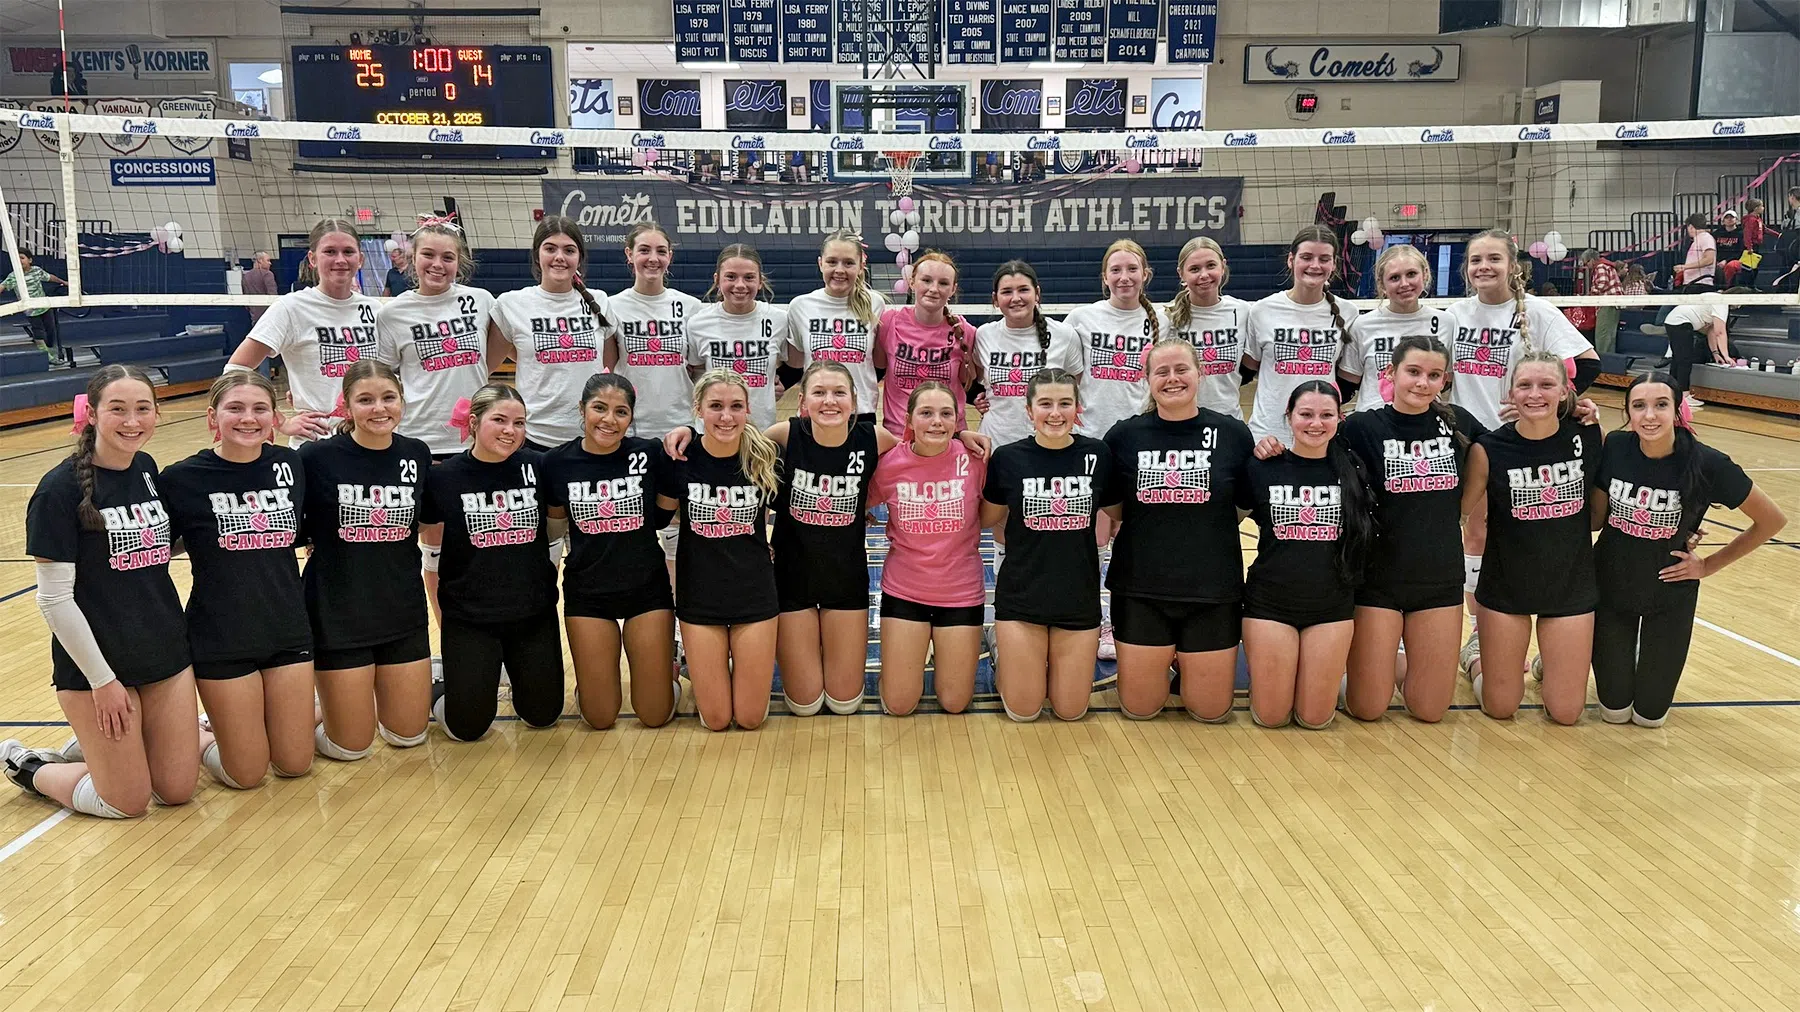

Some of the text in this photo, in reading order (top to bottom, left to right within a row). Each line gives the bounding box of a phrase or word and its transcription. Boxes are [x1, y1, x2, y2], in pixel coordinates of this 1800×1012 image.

[676, 4, 720, 14] LISA FERRY
[730, 0, 774, 8] LISA FERRY
[784, 5, 828, 14] LISA FERRY
[966, 2, 990, 10] DIVING
[1004, 4, 1049, 14] LANCE WARD
[1169, 5, 1216, 16] CHEERLEADING
[690, 19, 708, 28] 1978
[742, 12, 762, 20] 1979
[798, 19, 816, 28] 1980
[949, 14, 995, 24] TED HARRIS
[1016, 19, 1036, 28] 2007
[1070, 12, 1092, 20] 2009
[734, 24, 772, 33] STATE CHAMPION
[962, 28, 982, 36] 2005
[1062, 24, 1100, 33] STATE CHAMPION
[685, 34, 724, 42] STATE CHAMPION
[734, 36, 772, 46] SHOT PUT
[788, 34, 826, 42] STATE CHAMPION
[1006, 33, 1046, 42] STATE CHAMPION
[1069, 36, 1088, 46] METER
[1183, 34, 1203, 44] STATE
[350, 50, 372, 60] HOME
[458, 50, 482, 60] GUEST
[682, 48, 719, 56] SHOT PUT
[740, 48, 767, 58] DISCUS
[788, 48, 826, 56] SHOT PUT
[1070, 49, 1088, 58] METER
[1118, 45, 1146, 56] 2014
[1175, 48, 1210, 59] CHAMPIONS
[71, 51, 124, 71] KENT'S
[144, 51, 210, 71] KORNER
[413, 48, 452, 72] 1:00
[1310, 48, 1396, 77] Comets
[356, 63, 384, 86] 25
[473, 65, 492, 86] 14
[409, 87, 436, 98] period
[445, 83, 456, 100] 0
[102, 104, 143, 114] VANDALIA
[162, 102, 212, 112] GREENVILLE
[20, 113, 55, 129] Comets
[122, 119, 157, 134] Comets
[376, 112, 482, 126] OCTOBER 21, 2025
[225, 122, 260, 137] Comets
[327, 126, 361, 140] Comets
[428, 128, 463, 142] Comets
[1421, 128, 1454, 142] Comets
[1518, 126, 1551, 140] Comets
[1616, 124, 1648, 138] Comets
[1712, 121, 1745, 136] Comets
[531, 131, 565, 146] Comets
[631, 133, 666, 148] Comets
[731, 134, 765, 149] Comets
[830, 135, 864, 150] Comets
[929, 135, 962, 150] Comets
[1027, 135, 1061, 150] Comets
[1126, 133, 1158, 148] Comets
[1224, 132, 1258, 146] Comets
[1322, 130, 1356, 144] Comets
[114, 162, 210, 174] CONCESSIONS
[560, 190, 654, 226] Comets
[676, 200, 864, 234] EDUCATION
[1044, 196, 1228, 232] ATHLETICS
[458, 296, 478, 314] 22
[672, 301, 683, 318] 13
[358, 304, 375, 324] 20
[1232, 308, 1238, 326] 1
[410, 316, 478, 340] BLOCK
[530, 317, 594, 333] BLOCK
[622, 320, 683, 336] BLOCK
[762, 318, 772, 338] 16
[809, 318, 868, 334] BLOCK
[1143, 318, 1150, 336] 8
[1431, 316, 1438, 334] 9
[315, 326, 376, 344] BLOCK
[1274, 328, 1337, 344] BLOCK
[1456, 326, 1516, 346] BLOCK
[710, 340, 770, 358] BLOCK
[814, 350, 861, 363] CANCER
[895, 343, 954, 362] BLOCK
[426, 352, 479, 372] CANCER
[540, 350, 593, 364] CANCER
[628, 354, 680, 366] CANCER
[990, 352, 1047, 368] BLOCK
[1278, 362, 1330, 376] CANCER
[1202, 427, 1218, 449] 31
[1572, 434, 1582, 457] 3
[1383, 436, 1454, 458] BLOCK
[628, 452, 648, 475] 22
[846, 450, 865, 474] 25
[956, 454, 969, 476] 12
[1084, 454, 1098, 474] 17
[1138, 450, 1211, 470] BLOCK
[272, 462, 294, 486] 20
[400, 459, 418, 483] 29
[521, 464, 536, 486] 14
[1507, 459, 1584, 488] BLOCK
[568, 476, 643, 501] BLOCK
[794, 468, 862, 496] BLOCK
[1023, 476, 1092, 498] BLOCK
[1390, 476, 1454, 493] CANCER
[338, 484, 415, 507] BLOCK
[688, 483, 760, 507] BLOCK
[896, 480, 966, 502] BLOCK
[1142, 490, 1205, 504] CANCER
[1269, 485, 1342, 506] BLOCK
[1610, 478, 1682, 510] BLOCK
[208, 488, 294, 514] BLOCK
[460, 488, 538, 512] BLOCK
[100, 500, 170, 530] BLOCK
[794, 510, 850, 526] CANCER
[1518, 502, 1580, 520] CANCER
[582, 517, 639, 534] CANCER
[696, 522, 750, 538] CANCER
[903, 520, 960, 534] CANCER
[1030, 516, 1086, 530] CANCER
[1611, 515, 1672, 540] CANCER
[225, 531, 292, 550] CANCER
[345, 527, 406, 542] CANCER
[476, 529, 534, 548] CANCER
[1278, 526, 1337, 540] CANCER
